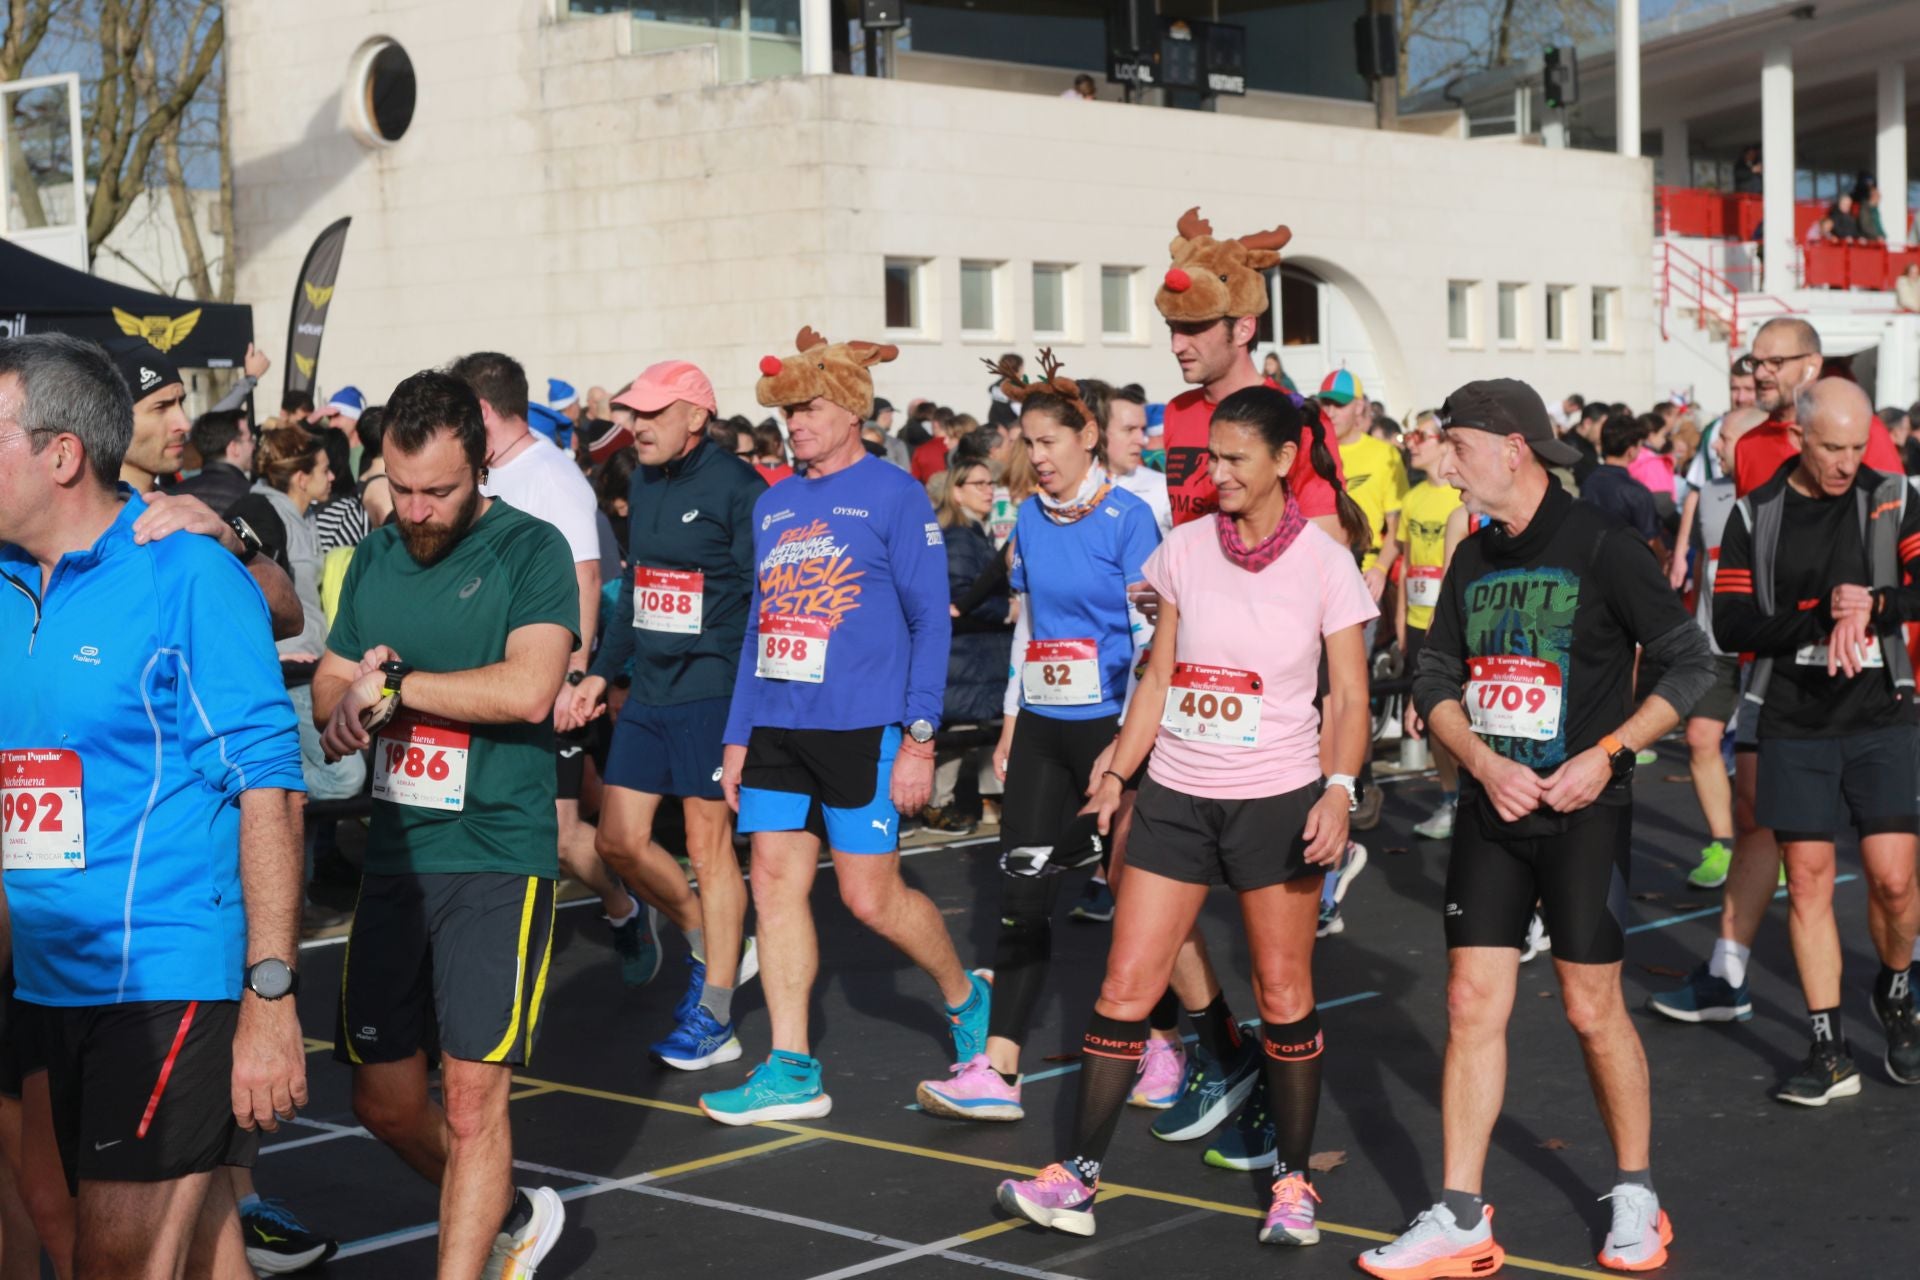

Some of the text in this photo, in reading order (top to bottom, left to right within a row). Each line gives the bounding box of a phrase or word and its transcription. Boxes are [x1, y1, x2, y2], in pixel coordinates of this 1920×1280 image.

[1115, 63, 1154, 82] LOCAL
[832, 506, 869, 518] OYSHO
[776, 519, 832, 545] FELIZ
[641, 590, 692, 614] 1088
[1472, 580, 1559, 613] DON'T
[766, 636, 807, 661] 898
[1195, 665, 1221, 675] Carrera
[1221, 668, 1248, 678] Popular
[1520, 658, 1547, 668] Popular
[1042, 664, 1073, 687] 82
[1179, 691, 1243, 722] 400
[1478, 684, 1547, 714] 1709
[17, 764, 25, 774] de
[27, 752, 62, 764] Popular
[385, 742, 450, 781] 1986
[4, 775, 45, 786] Nochebuena
[3, 792, 63, 833] 992
